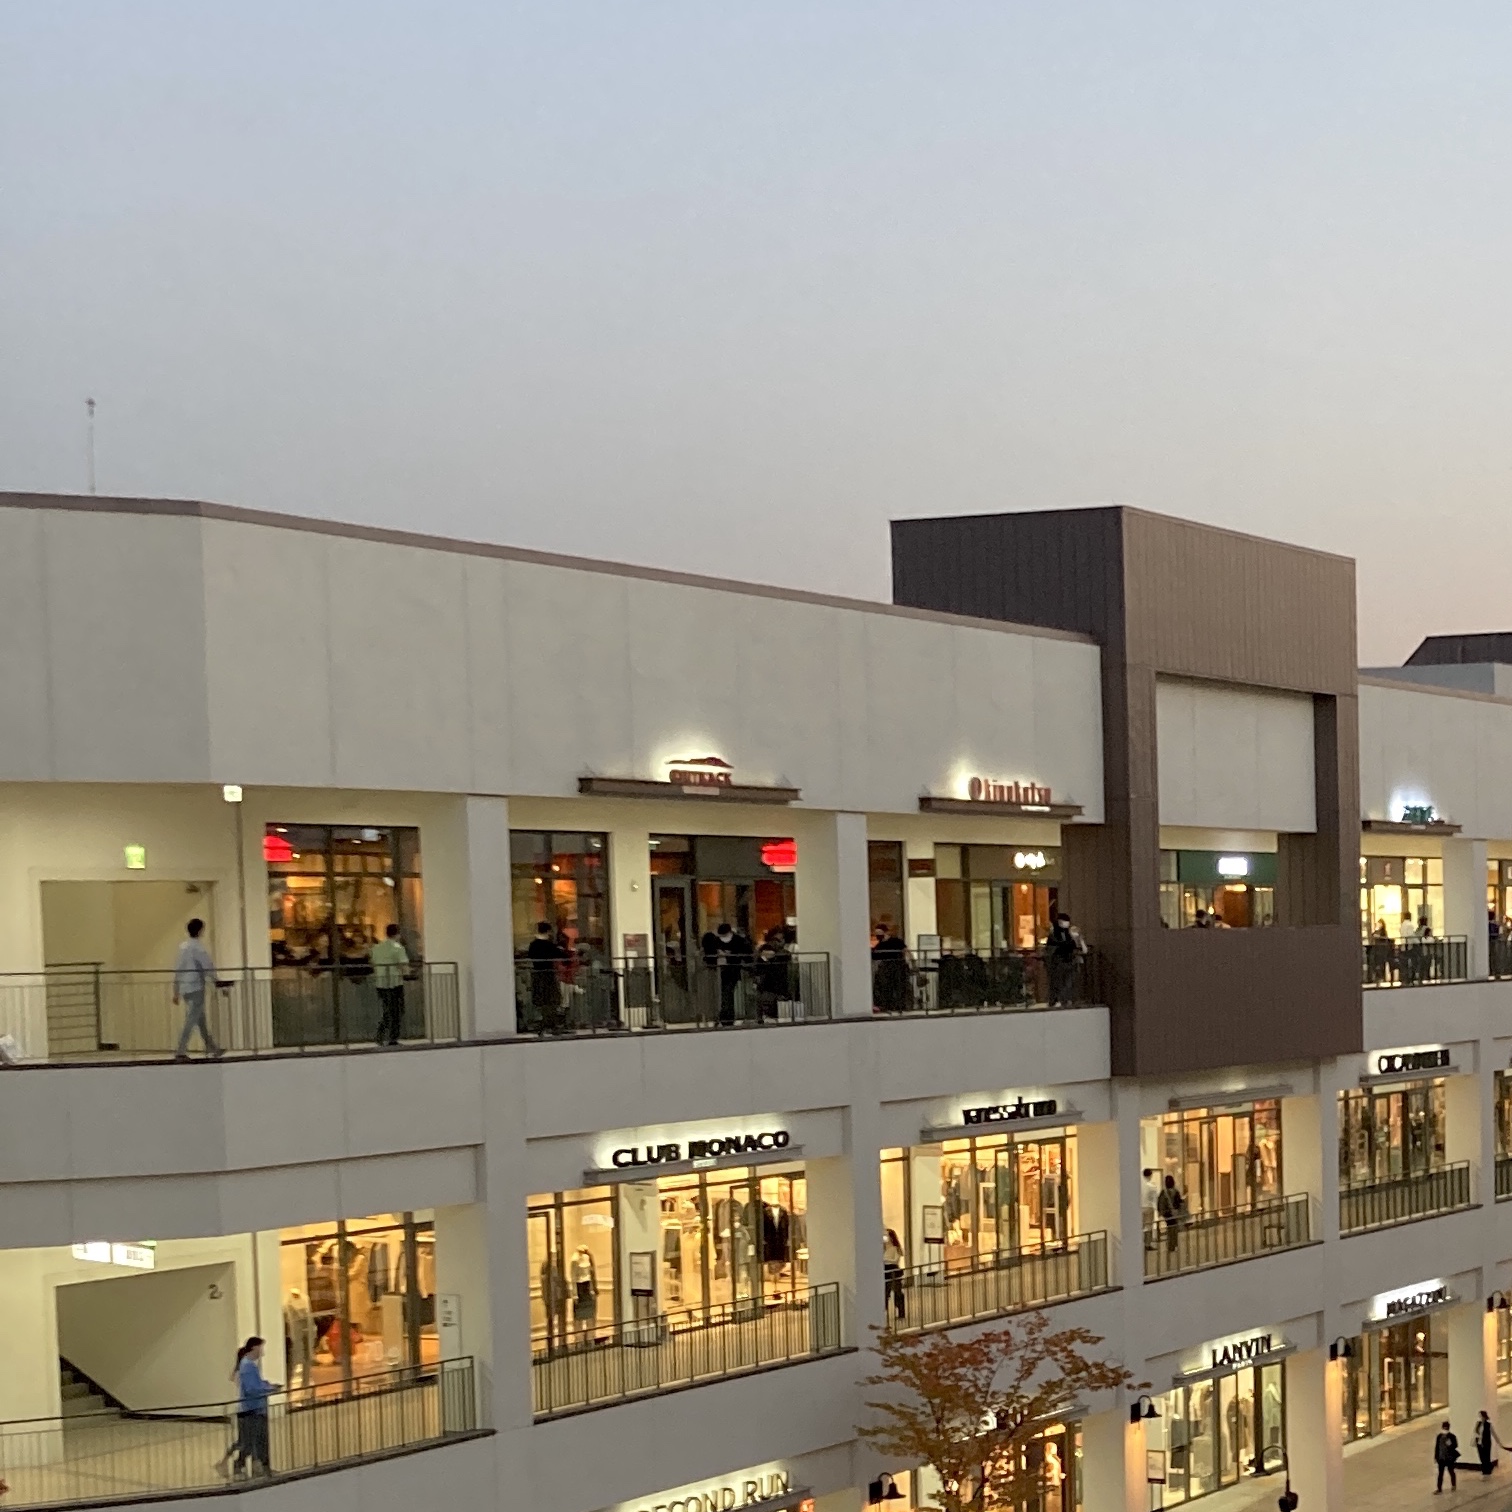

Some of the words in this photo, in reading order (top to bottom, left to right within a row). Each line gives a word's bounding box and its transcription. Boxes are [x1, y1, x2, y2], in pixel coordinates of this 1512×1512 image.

[612, 1143, 681, 1168] CLUB
[688, 1130, 789, 1159] MONACO
[1212, 1333, 1272, 1369] LANVIN
[742, 1470, 792, 1505] RUN
